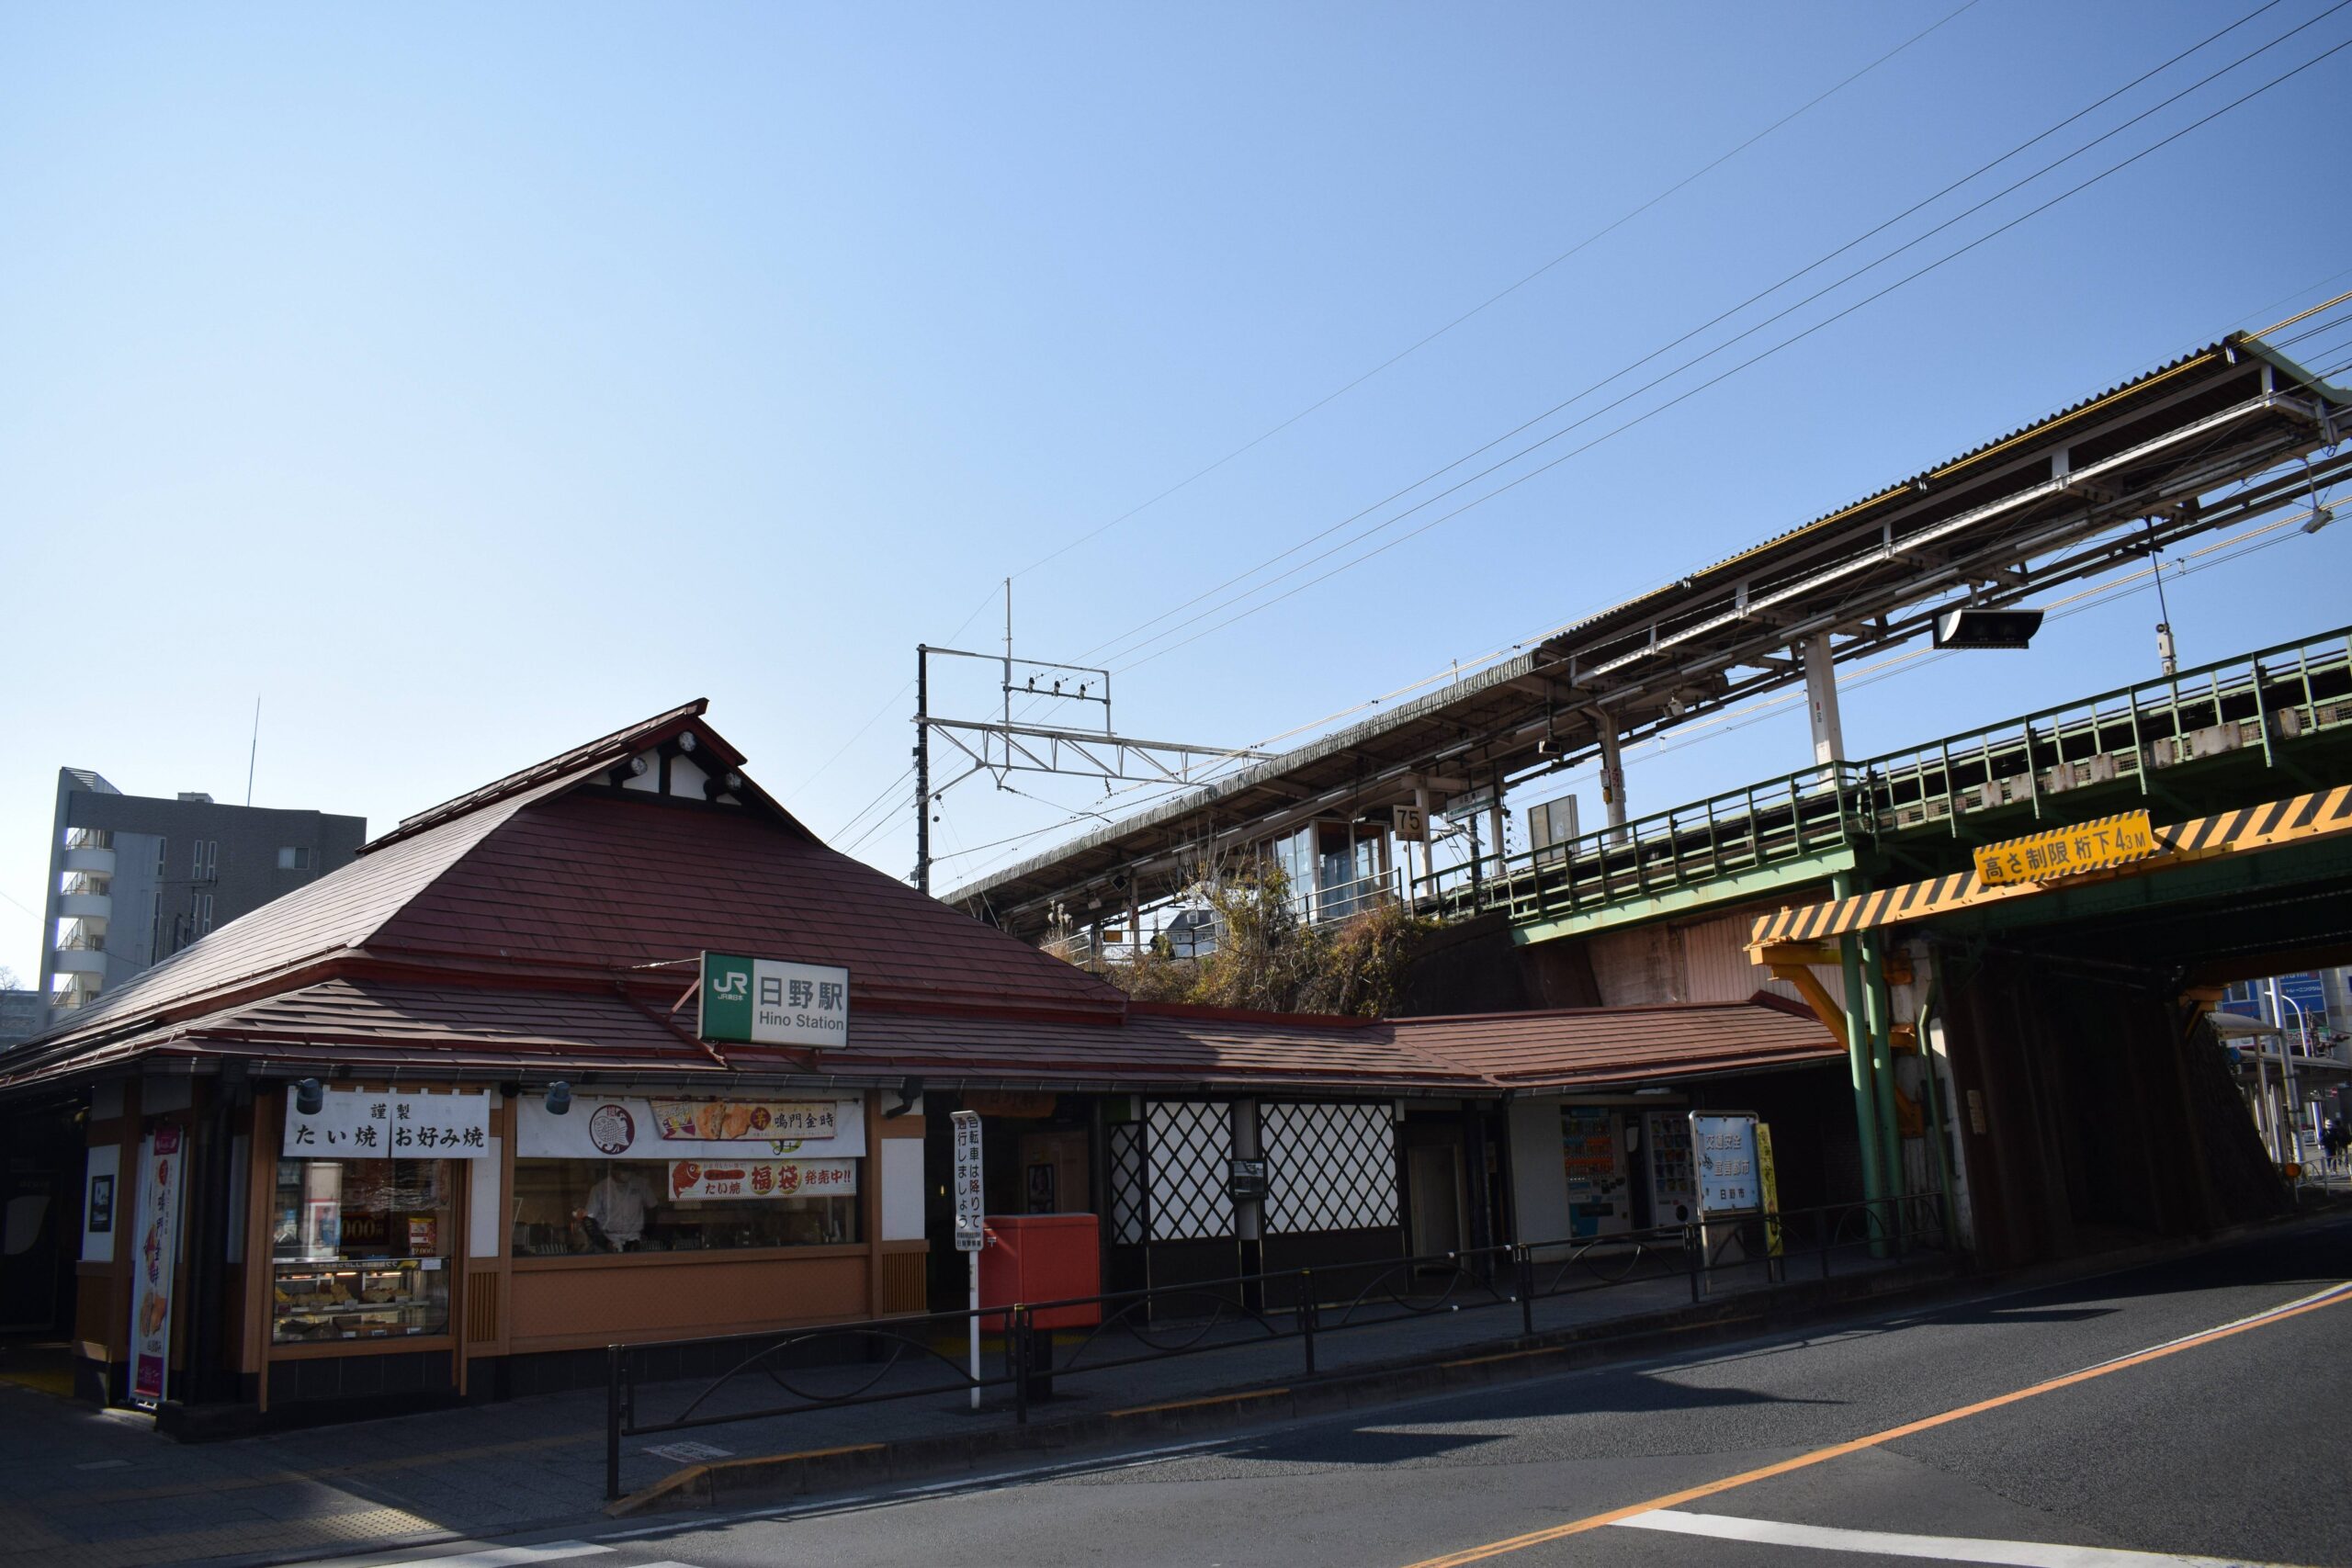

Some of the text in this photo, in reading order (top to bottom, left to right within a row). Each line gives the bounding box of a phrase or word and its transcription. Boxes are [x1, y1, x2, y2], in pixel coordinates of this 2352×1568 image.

[1396, 809, 1420, 830] 75
[713, 971, 748, 995] JR
[760, 976, 843, 1011] 日野駅
[718, 994, 743, 1002] JR東日本
[759, 1011, 844, 1031] Hino Station
[775, 1111, 834, 1129] 鳴門金時
[296, 1123, 485, 1148] たい焼 お好み焼
[752, 1165, 798, 1190] 福袋
[956, 1117, 967, 1229] 通行しましょう
[967, 1116, 981, 1228] 自転車は降りて
[705, 1182, 741, 1195] たい焼
[1720, 1189, 1745, 1200] 日野市
